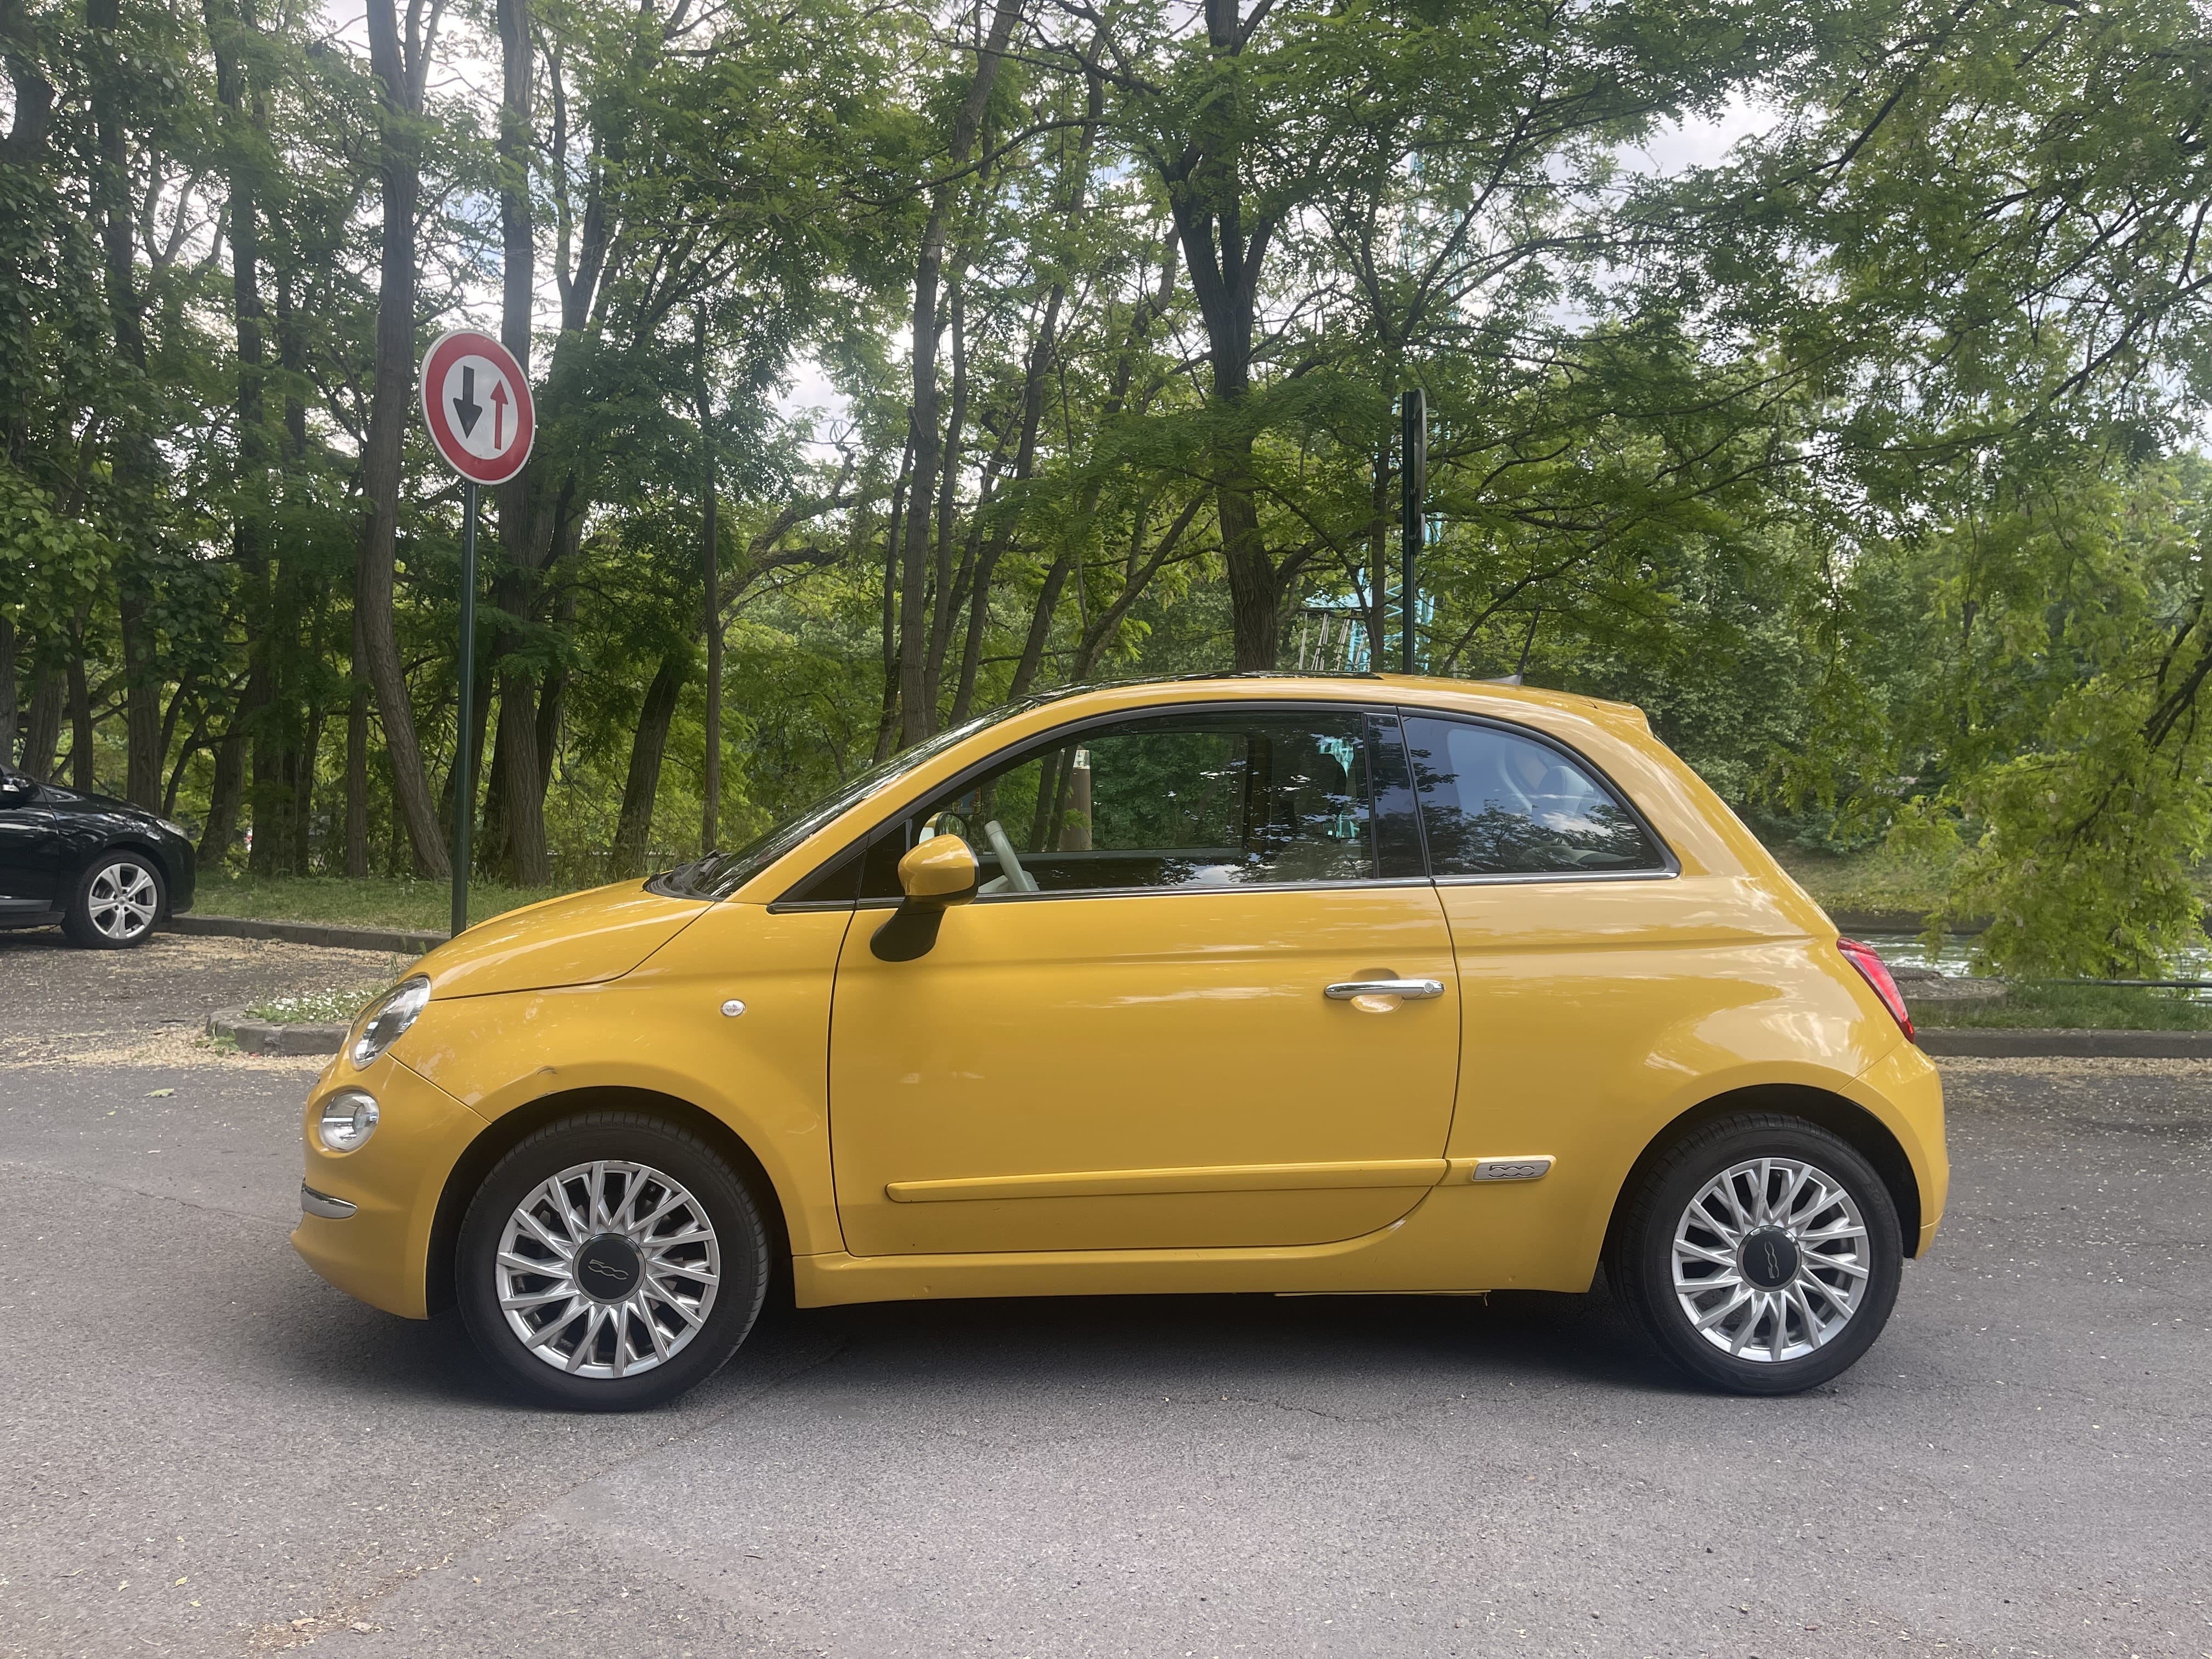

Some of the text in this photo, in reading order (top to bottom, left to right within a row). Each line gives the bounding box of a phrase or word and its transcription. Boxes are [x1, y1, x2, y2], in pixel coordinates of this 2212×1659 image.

[1488, 1164, 1535, 1177] 500
[588, 1259, 629, 1280] 500
[1764, 1241, 1780, 1279] 500
